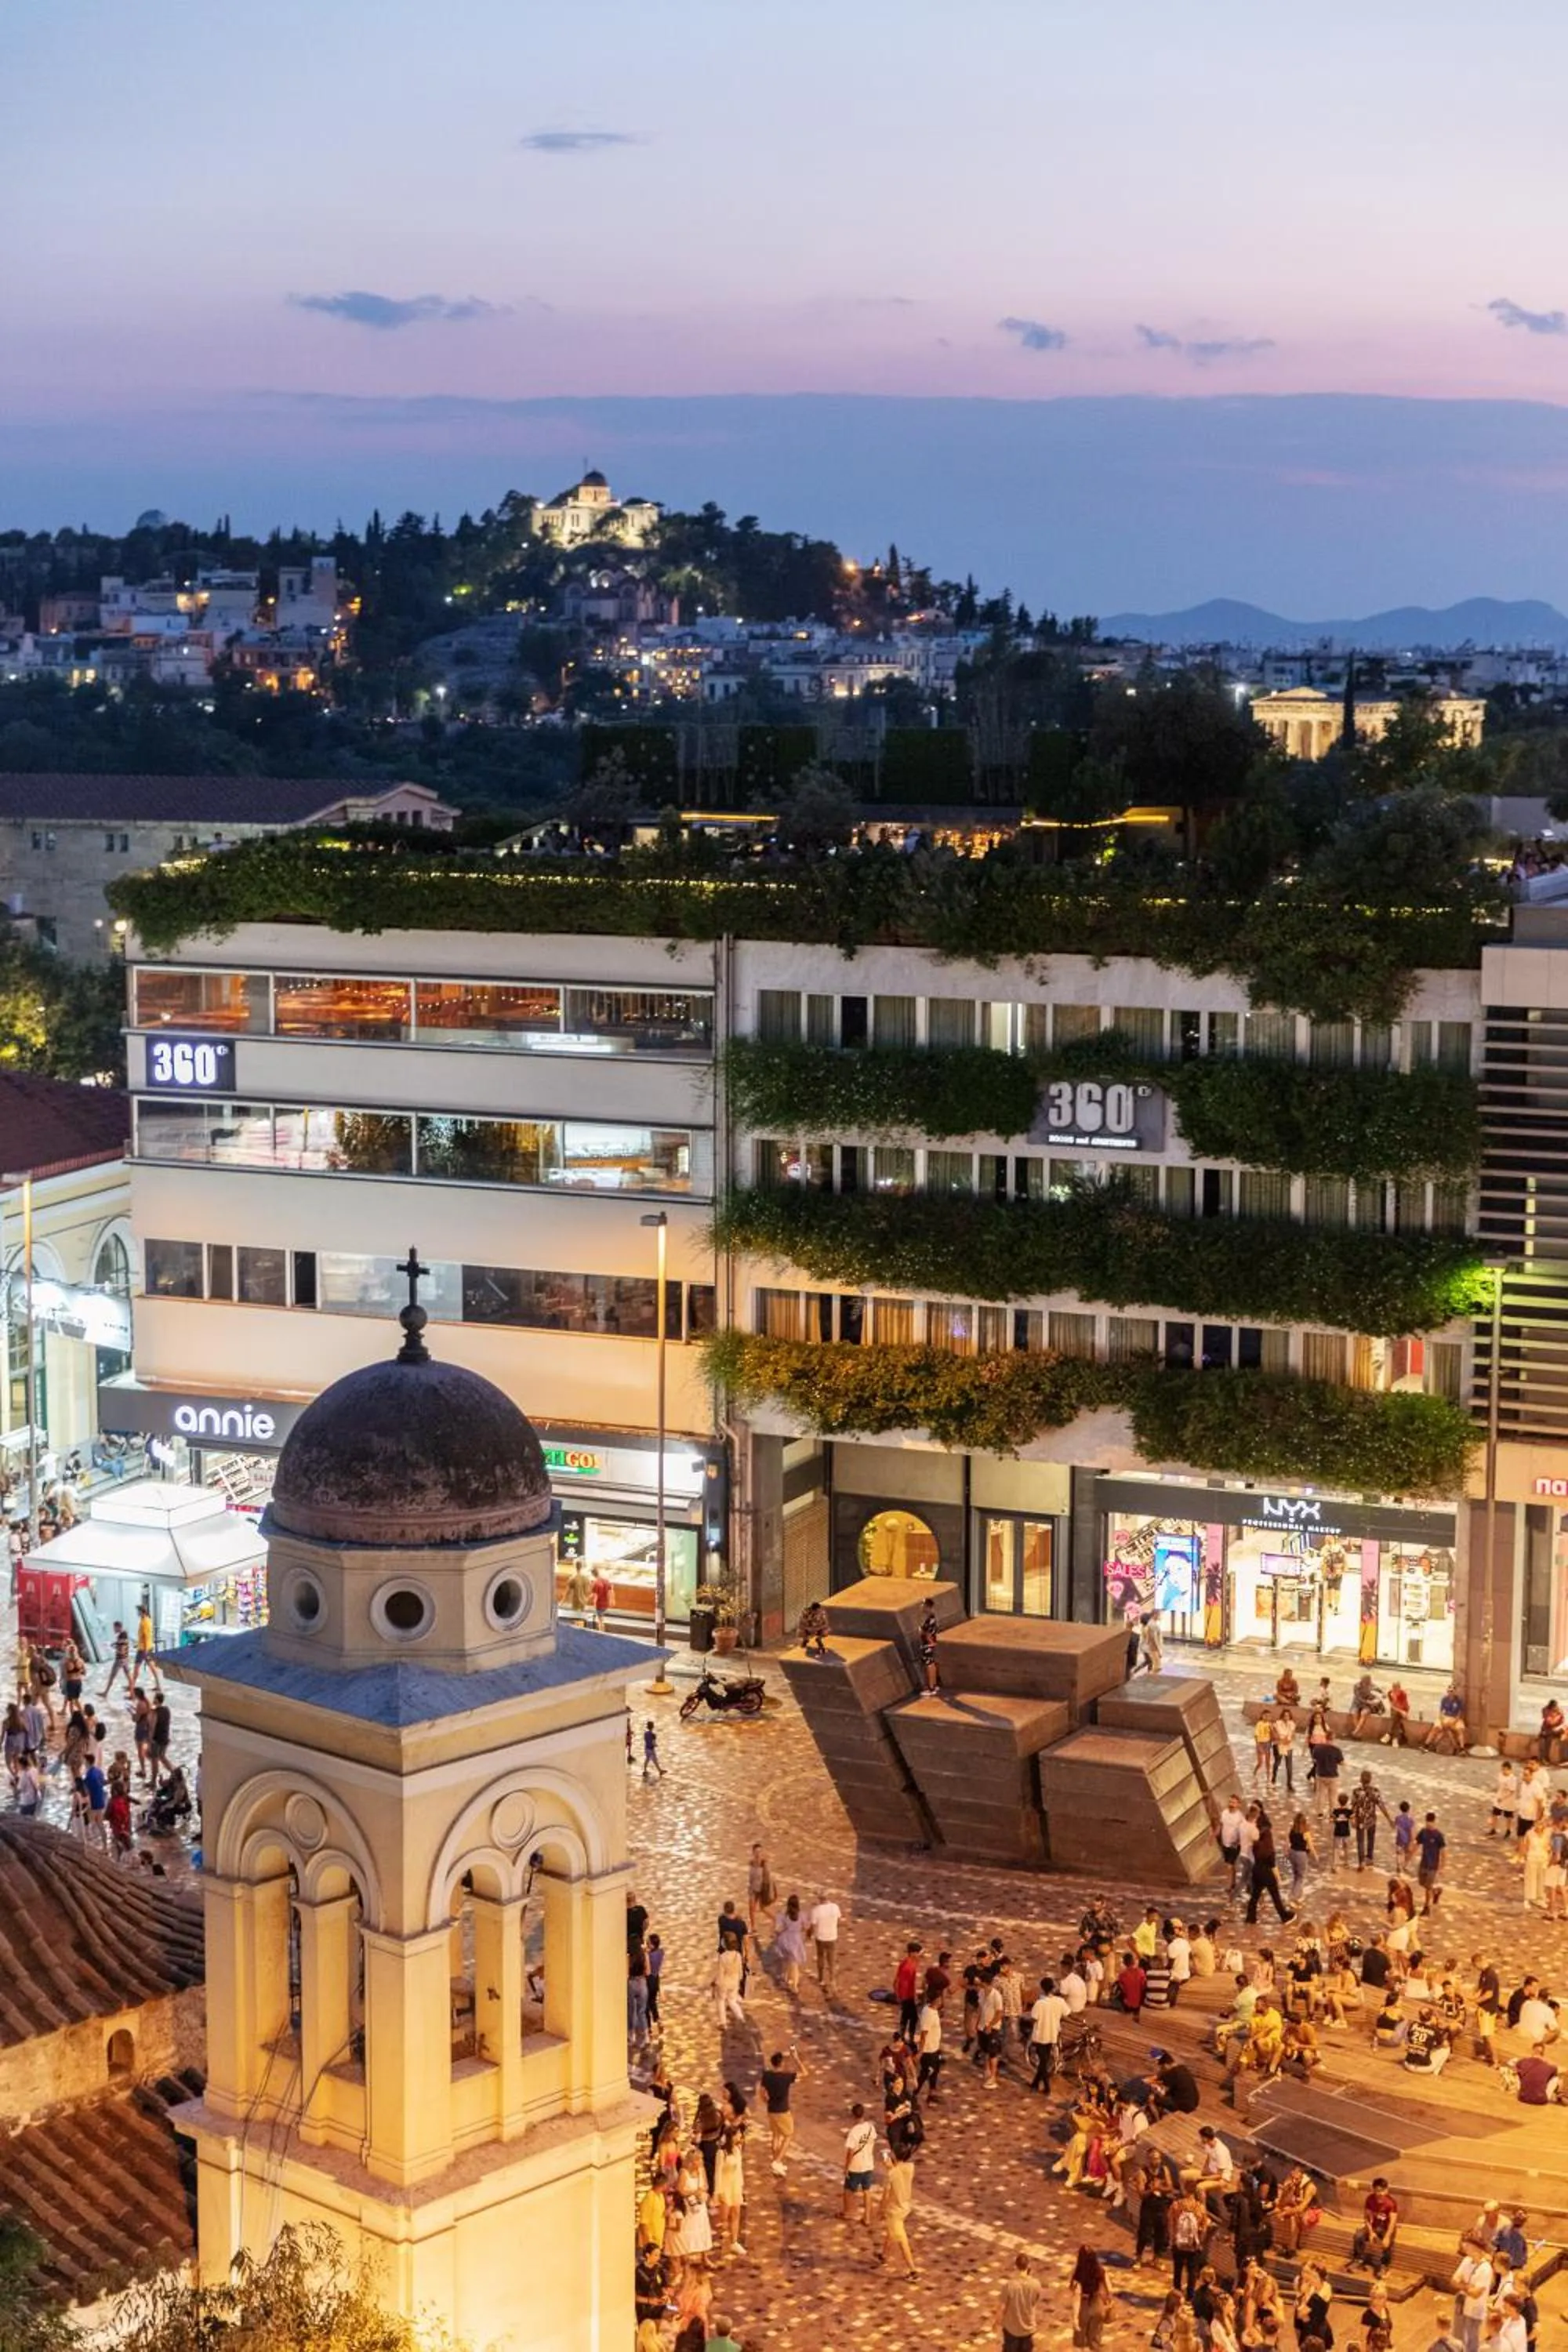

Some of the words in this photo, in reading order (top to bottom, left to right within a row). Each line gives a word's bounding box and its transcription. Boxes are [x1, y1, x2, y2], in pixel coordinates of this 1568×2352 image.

[175, 1404, 276, 1439] annie
[1263, 1497, 1321, 1523] NYX
[1106, 1561, 1146, 1579] SALES
